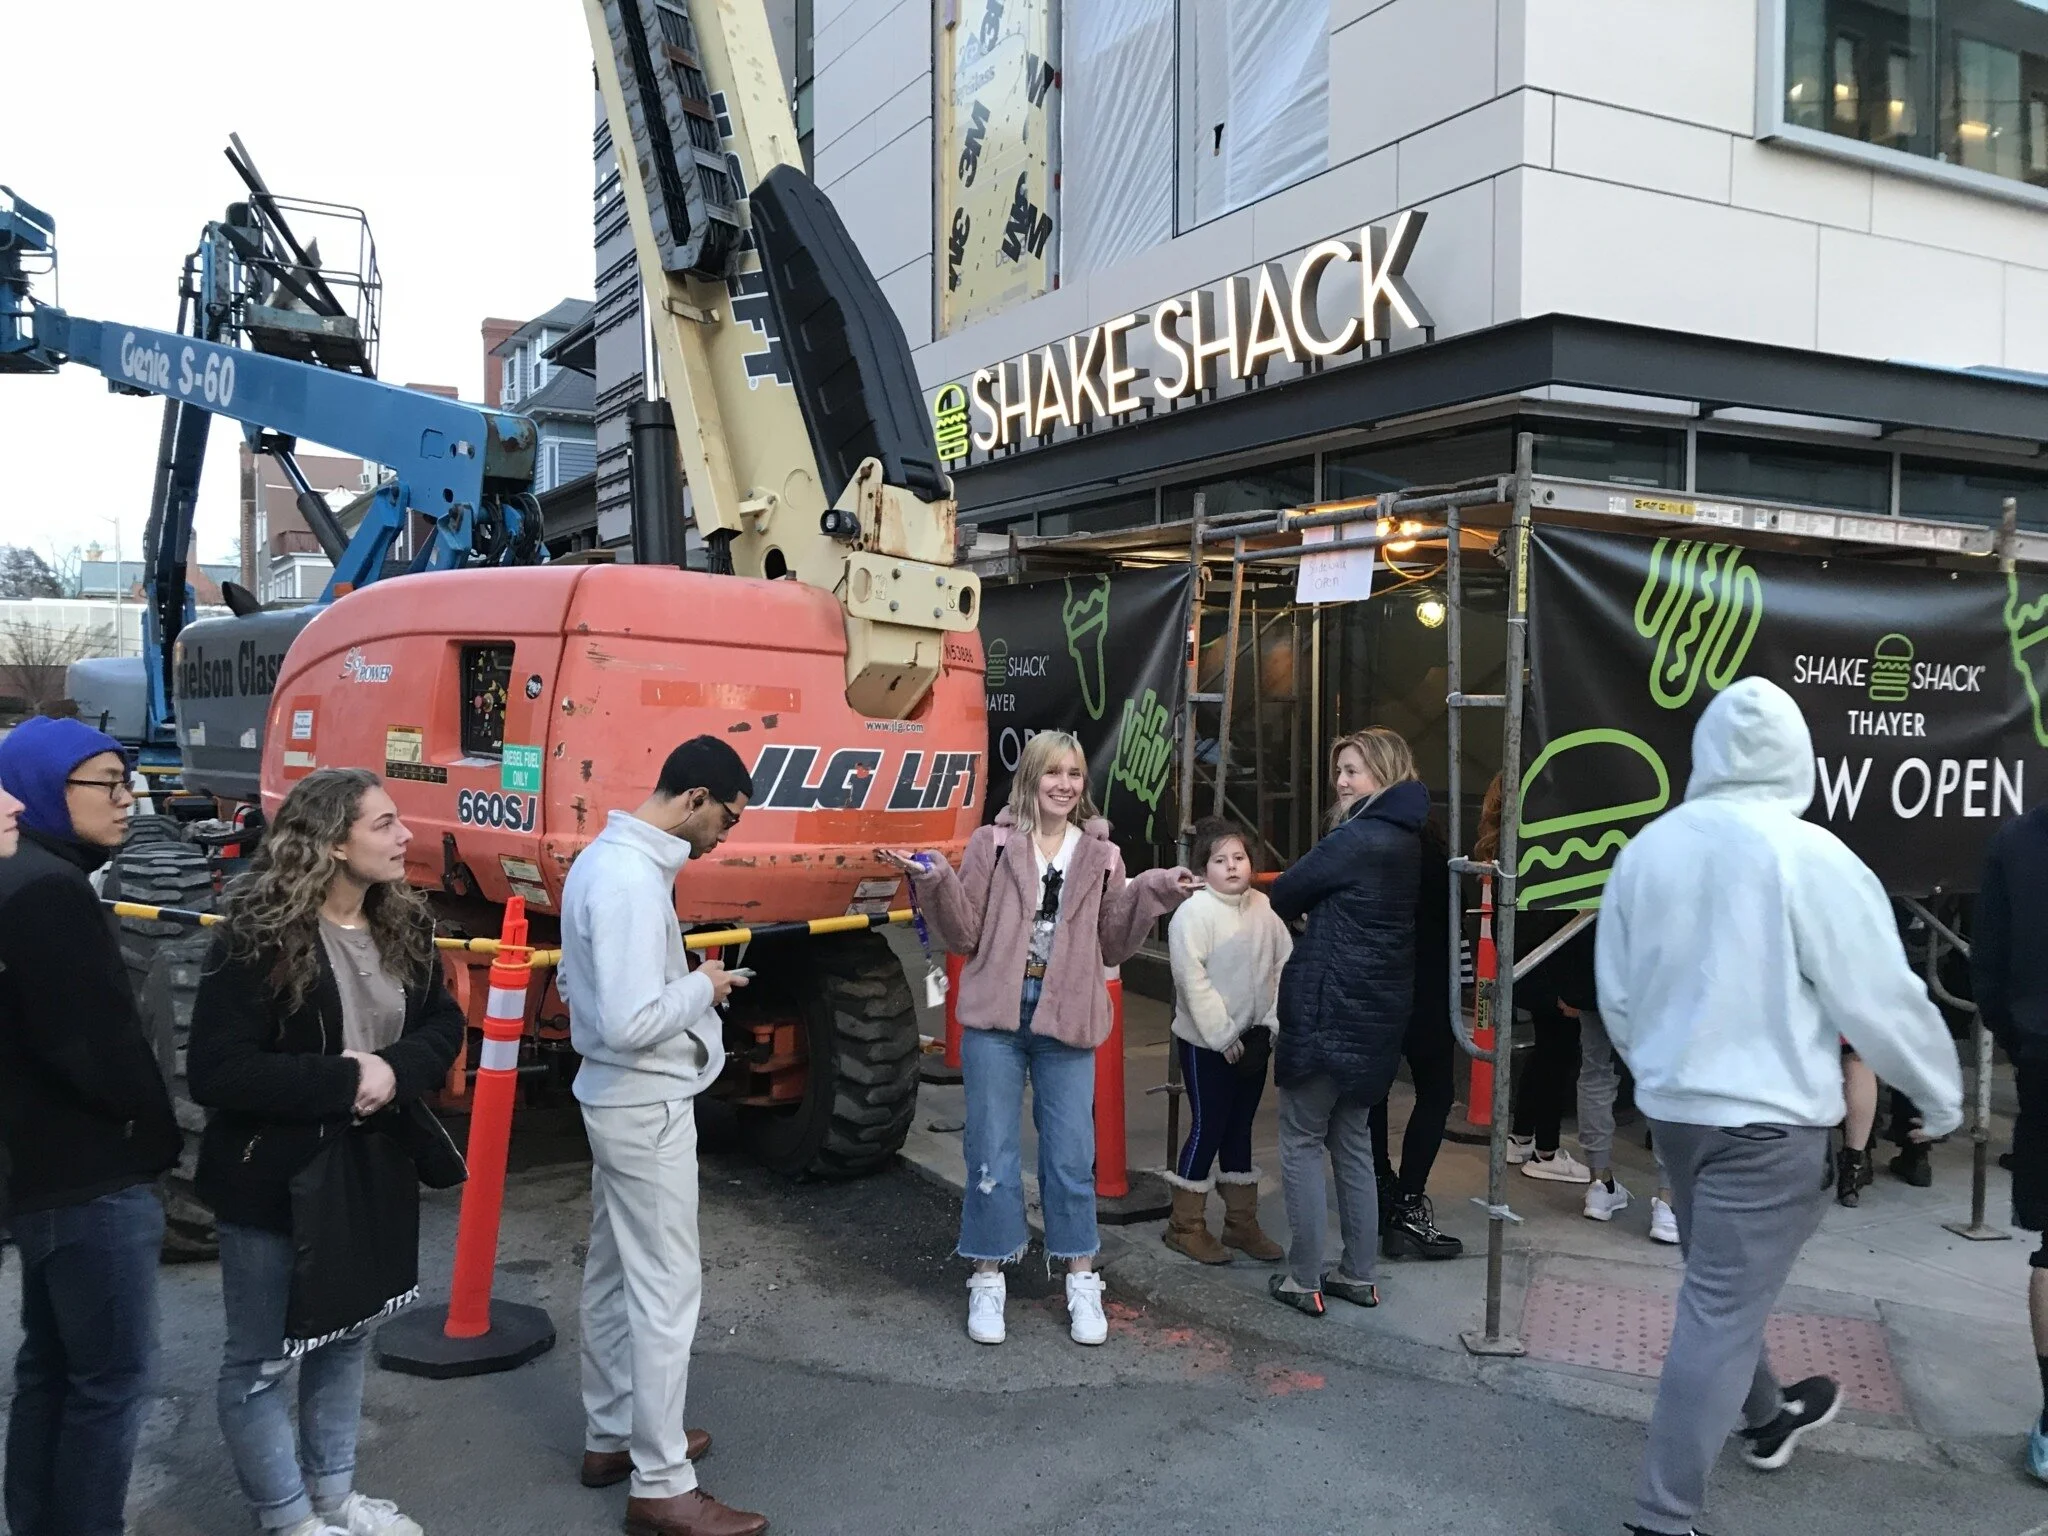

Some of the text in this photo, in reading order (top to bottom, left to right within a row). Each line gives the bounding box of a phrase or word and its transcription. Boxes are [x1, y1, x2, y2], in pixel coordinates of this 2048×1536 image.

[972, 313, 1152, 451] SHAKE
[1154, 209, 1434, 399] SHACK
[121, 331, 235, 407] Genie S-60
[1007, 655, 1048, 677] SHACK
[1793, 654, 1982, 692] SHAKE SHACK
[866, 720, 924, 733] www.jlg.com
[1848, 709, 1927, 737] THAYER
[504, 749, 540, 769] DIESEL FUEL
[512, 770, 529, 786] ONLY
[744, 744, 885, 812] JLG
[1891, 756, 2025, 820] OPEN
[458, 788, 537, 833] 660SJ
